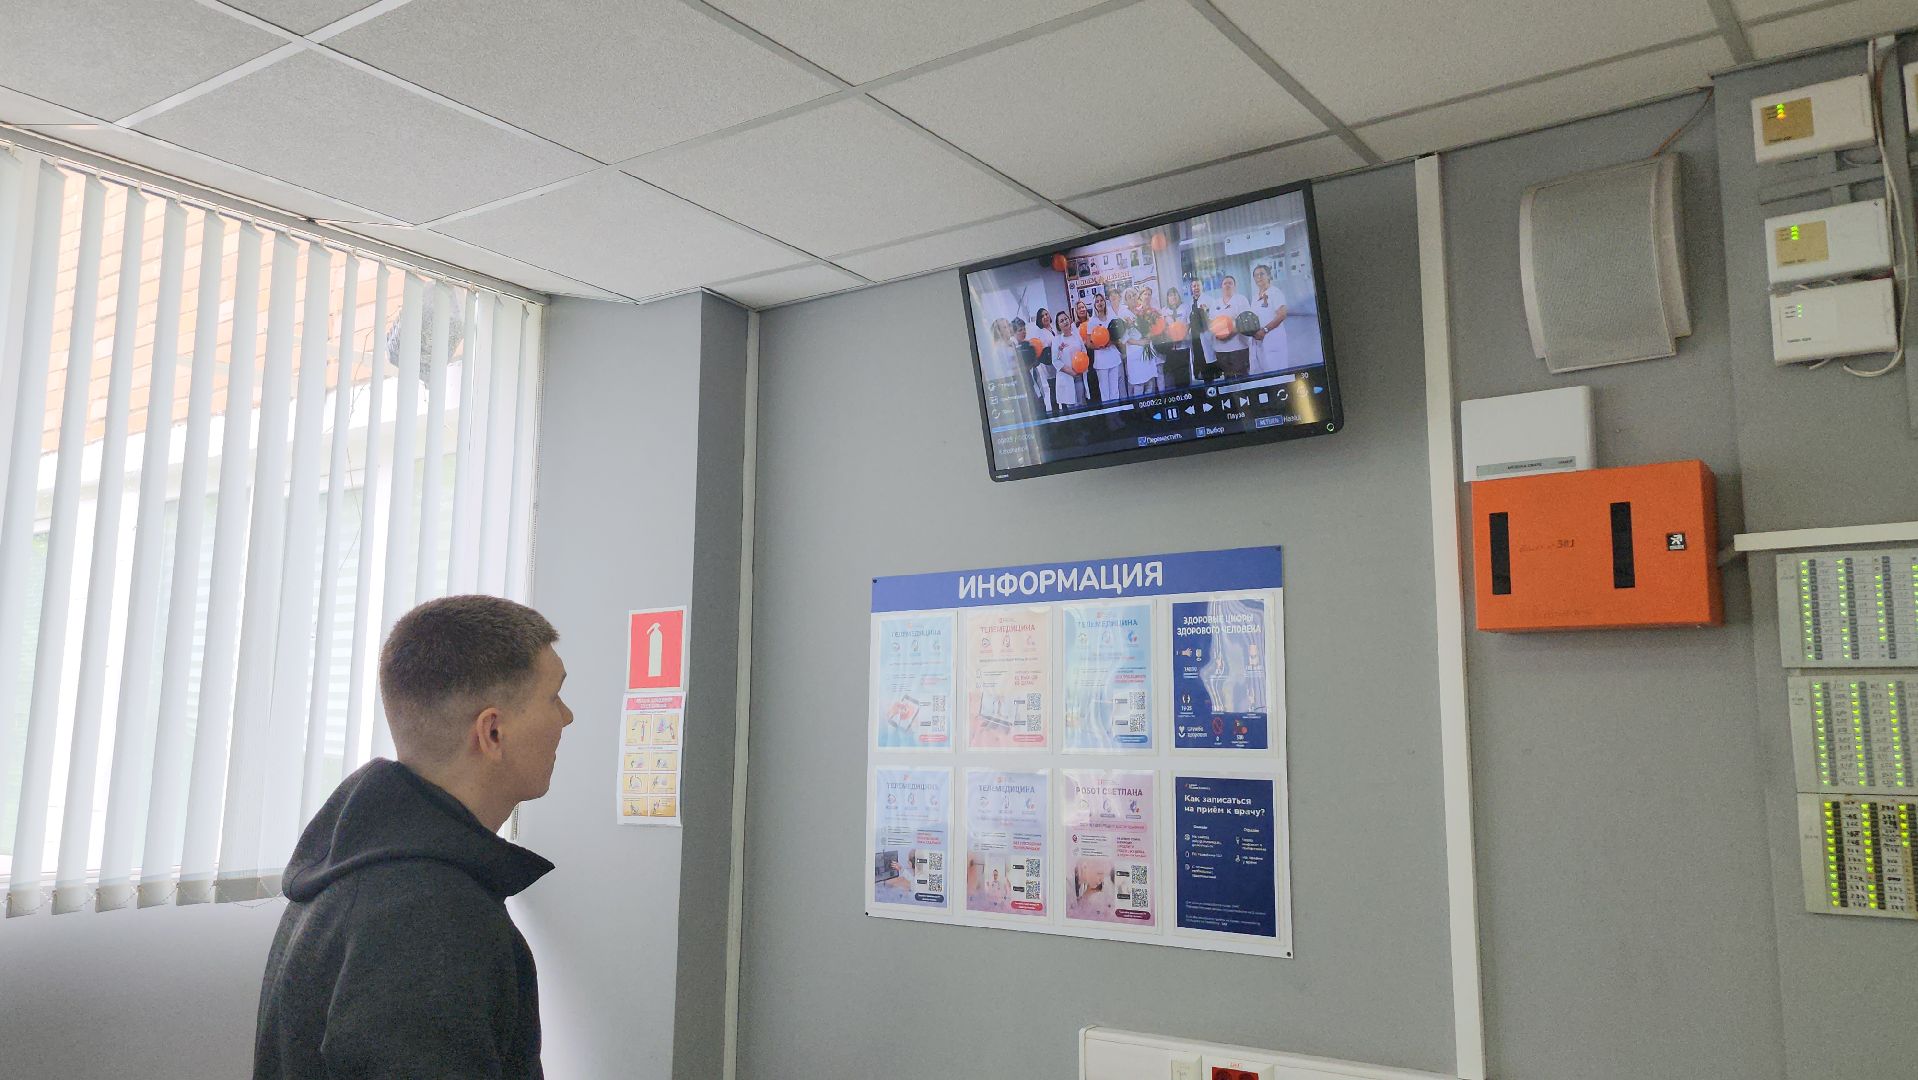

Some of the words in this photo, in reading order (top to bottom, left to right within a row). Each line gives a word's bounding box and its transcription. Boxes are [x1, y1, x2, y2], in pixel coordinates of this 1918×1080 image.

[1226, 412, 1246, 421] Пауза
[1206, 426, 1225, 436] Выбор
[959, 561, 1163, 598] ИНФОРМАЦИЯ
[1183, 615, 1225, 627] ЗДОРОВЫЕ
[979, 623, 1036, 634] ТЕЛЕМЕДИЦИНА
[1176, 625, 1221, 637] ЗДОРОВОГО
[1221, 624, 1262, 636] ЧЕЛОВЕКА
[978, 784, 1036, 794] ТЕЛЕМЕДИЦИНА
[1075, 786, 1100, 796] РОБОТ
[1102, 786, 1143, 797] СВЕТЛАНА
[1184, 794, 1201, 803] Как
[1202, 796, 1252, 805] записаться
[1196, 806, 1224, 815] приём
[1233, 808, 1266, 817] врачу?
